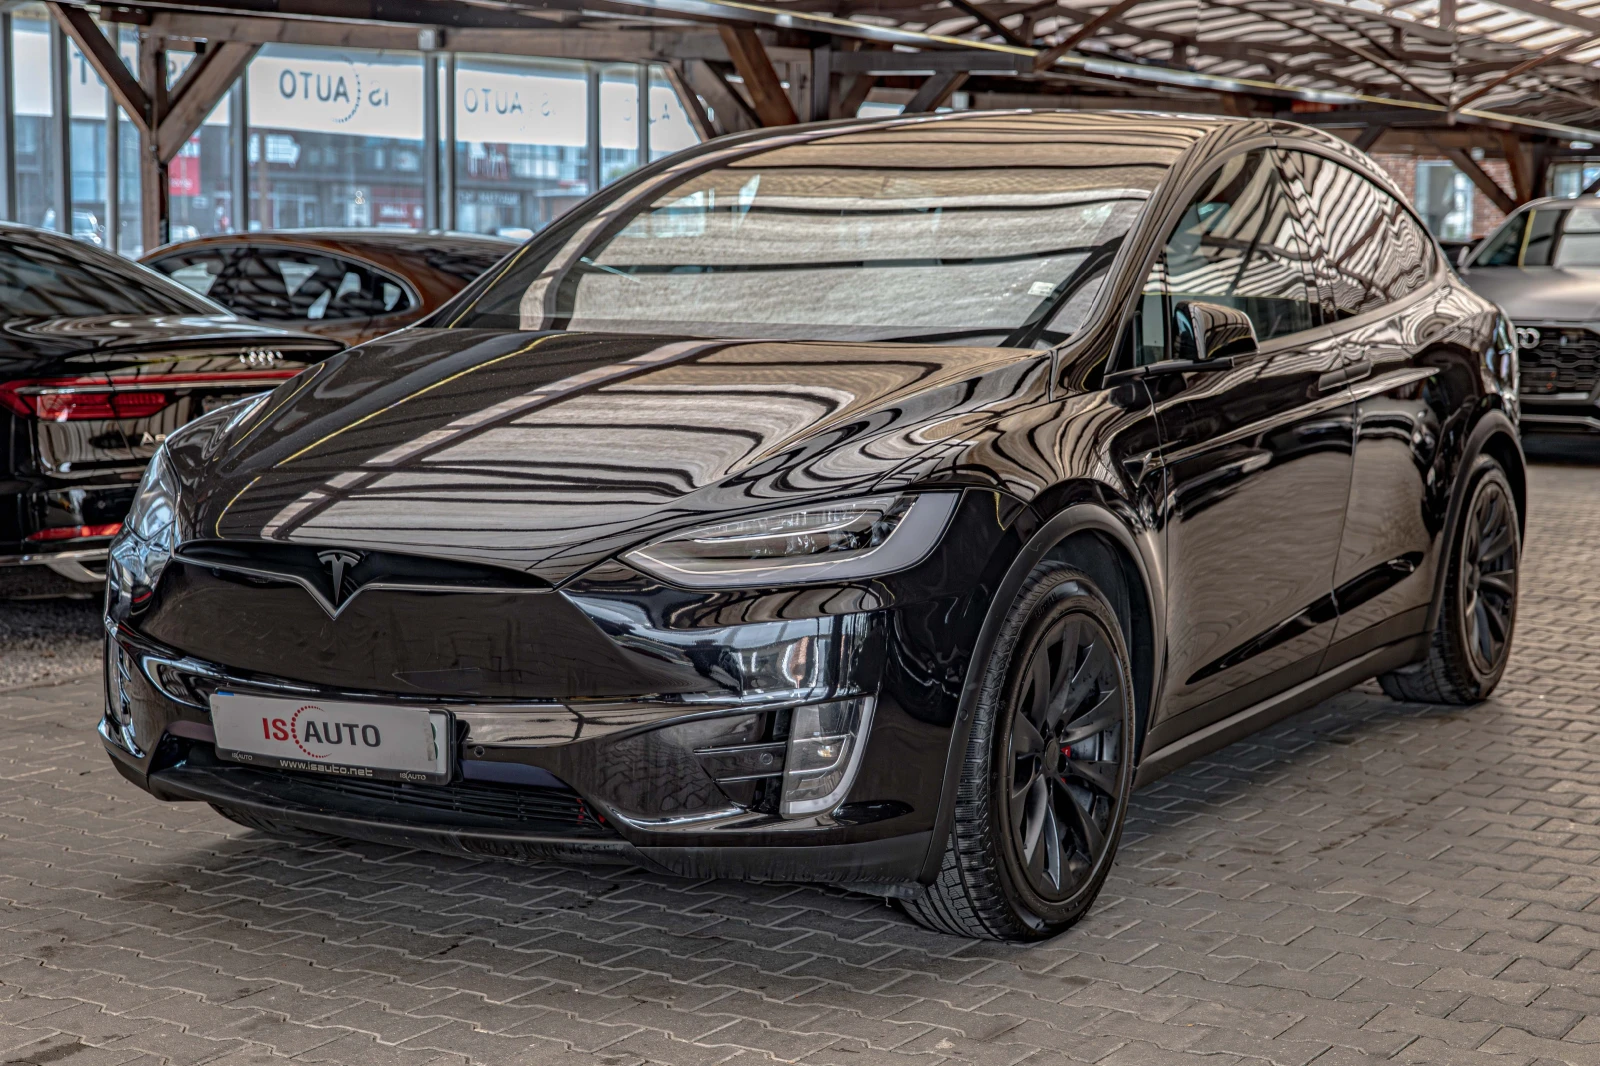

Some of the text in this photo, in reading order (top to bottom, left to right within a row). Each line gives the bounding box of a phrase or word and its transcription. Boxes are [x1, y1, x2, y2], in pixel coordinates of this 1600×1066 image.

[262, 717, 381, 748] IS AUTO
[279, 758, 374, 778] www.isauto.net
